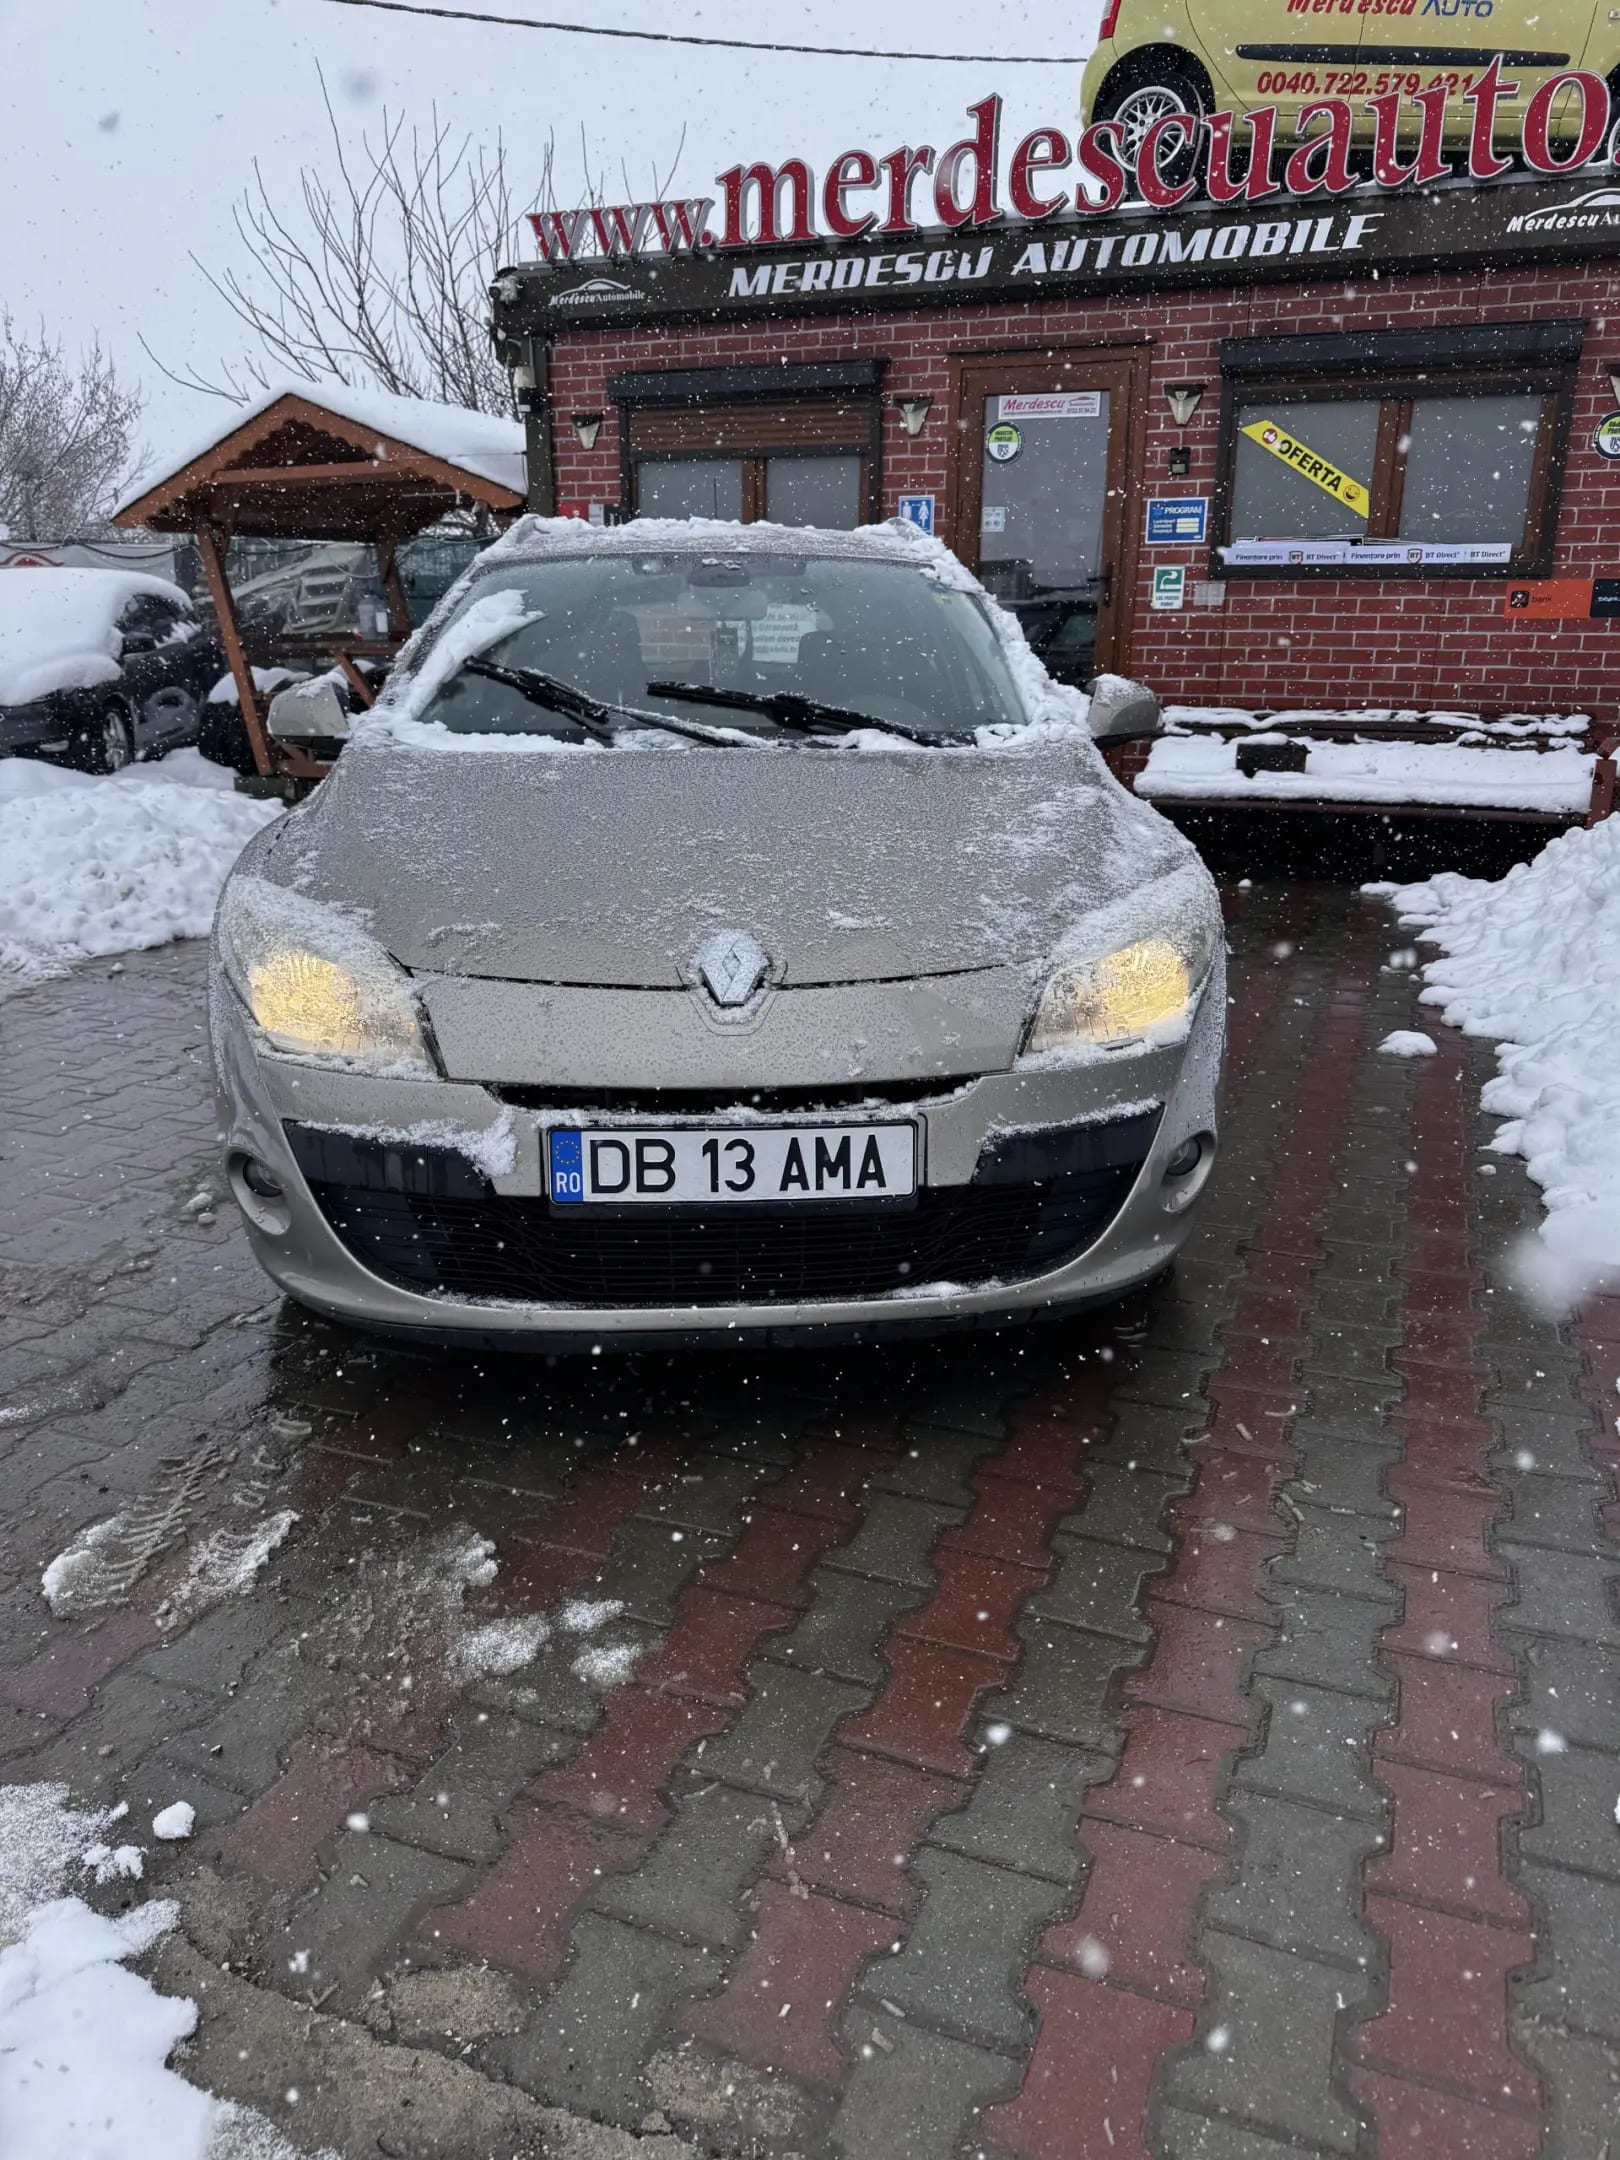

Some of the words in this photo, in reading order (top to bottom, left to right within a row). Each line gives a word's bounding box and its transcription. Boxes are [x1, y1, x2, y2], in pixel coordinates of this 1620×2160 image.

[1506, 213, 1599, 232] Merdescu
[728, 246, 994, 297] MERDESCU
[1011, 213, 1384, 277] AUTOMOBILE
[1003, 398, 1065, 411] Merdescu
[1278, 439, 1342, 492] OFERTA
[1164, 505, 1202, 515] PROGRAM
[590, 1138, 676, 1194] DB
[702, 1138, 756, 1193] 13
[779, 1134, 887, 1192] AMA
[556, 1171, 581, 1193] RO
